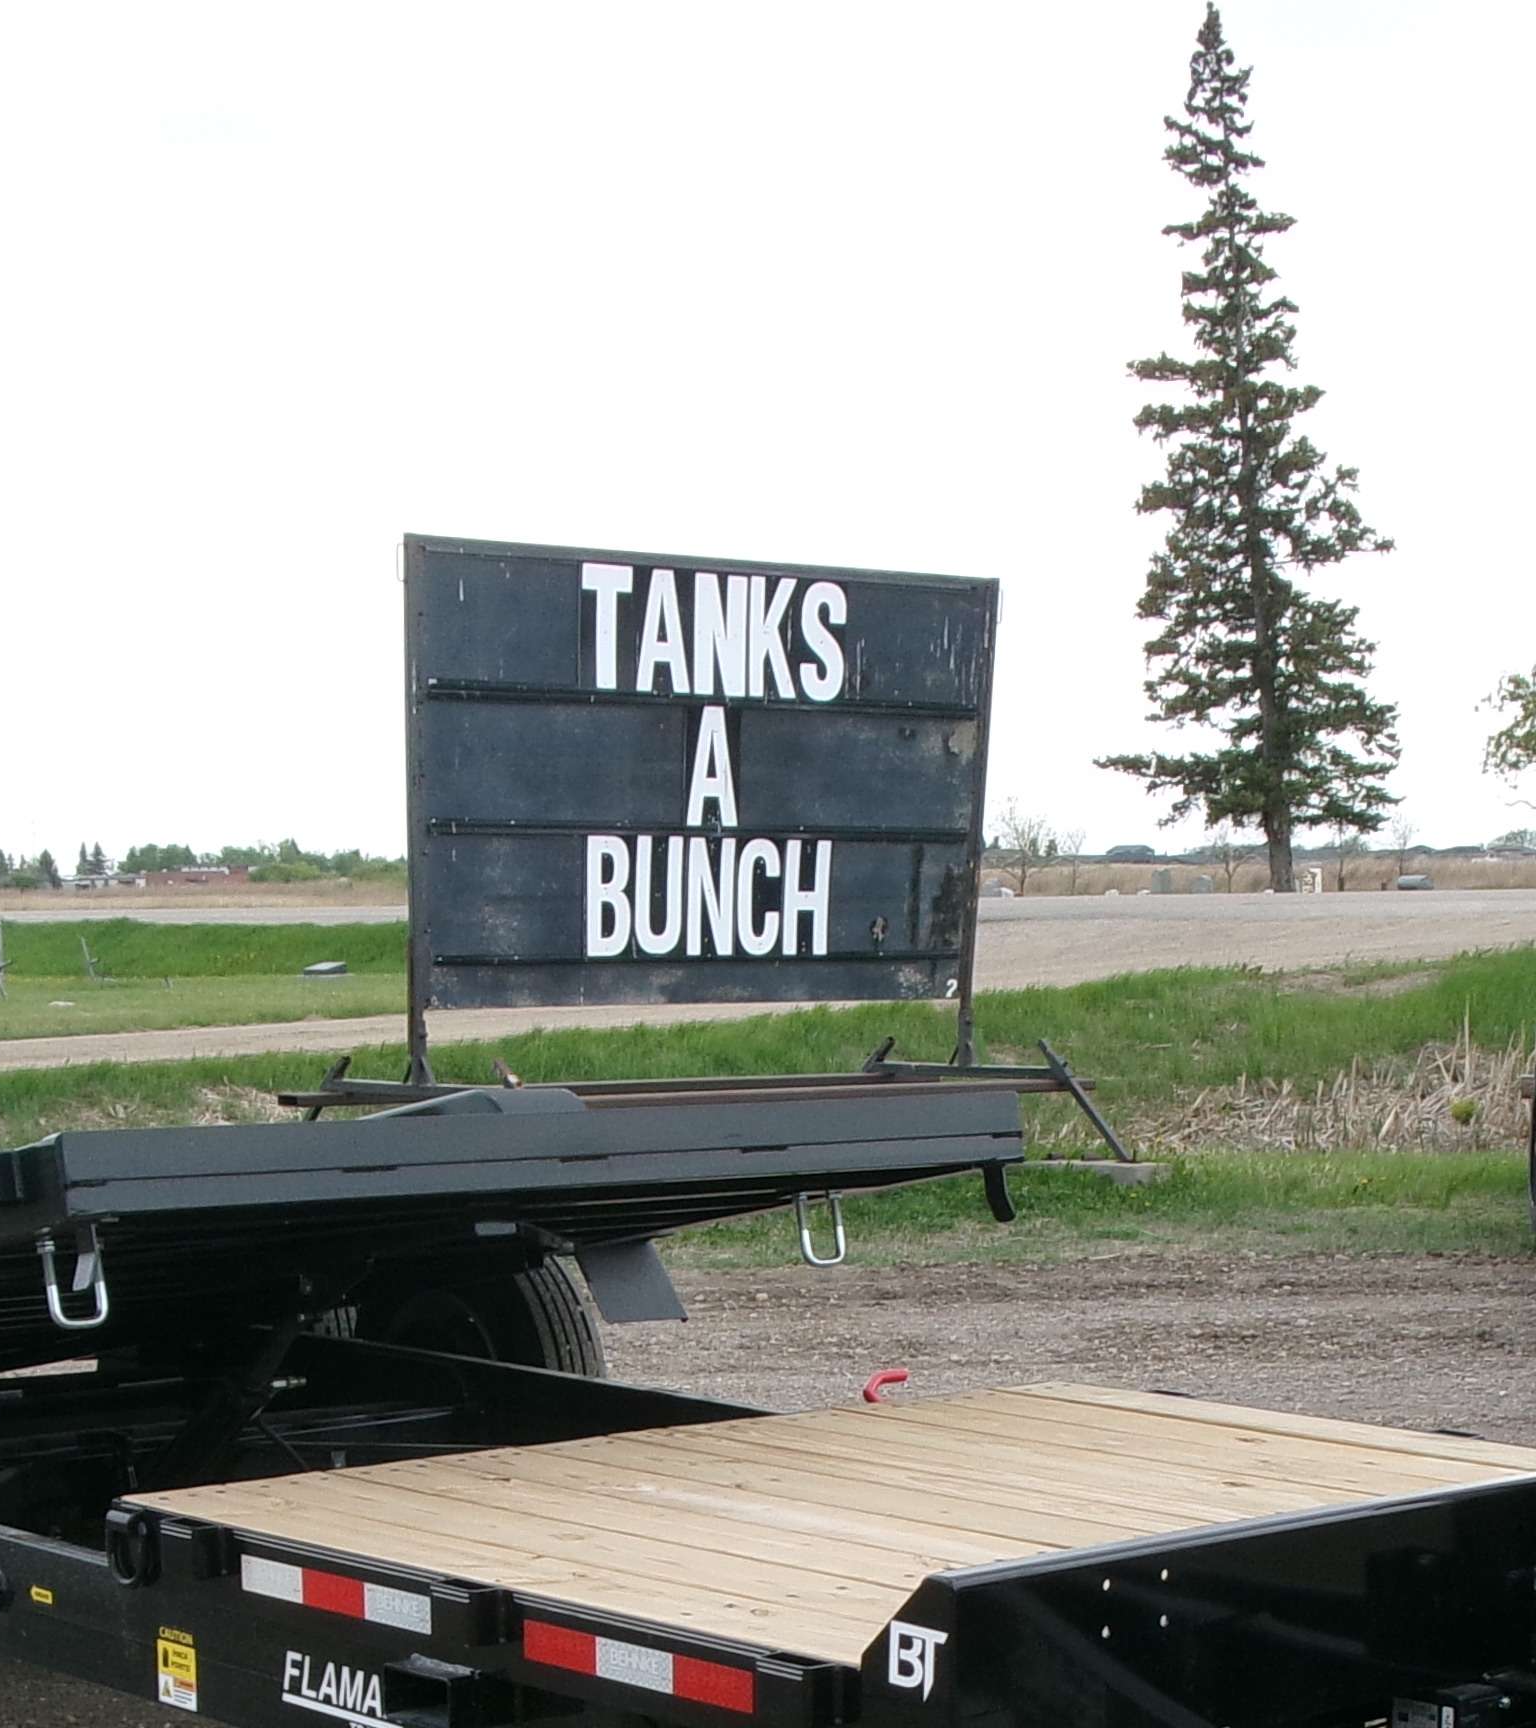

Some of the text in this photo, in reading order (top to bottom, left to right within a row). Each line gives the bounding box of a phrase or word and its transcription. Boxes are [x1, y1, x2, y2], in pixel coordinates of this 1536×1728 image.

[581, 562, 848, 702] TANKS
[685, 705, 738, 827] A
[585, 835, 833, 957] BUNCH
[283, 1649, 385, 1718] FLAMA
[610, 1647, 659, 1674] BEHNKE
